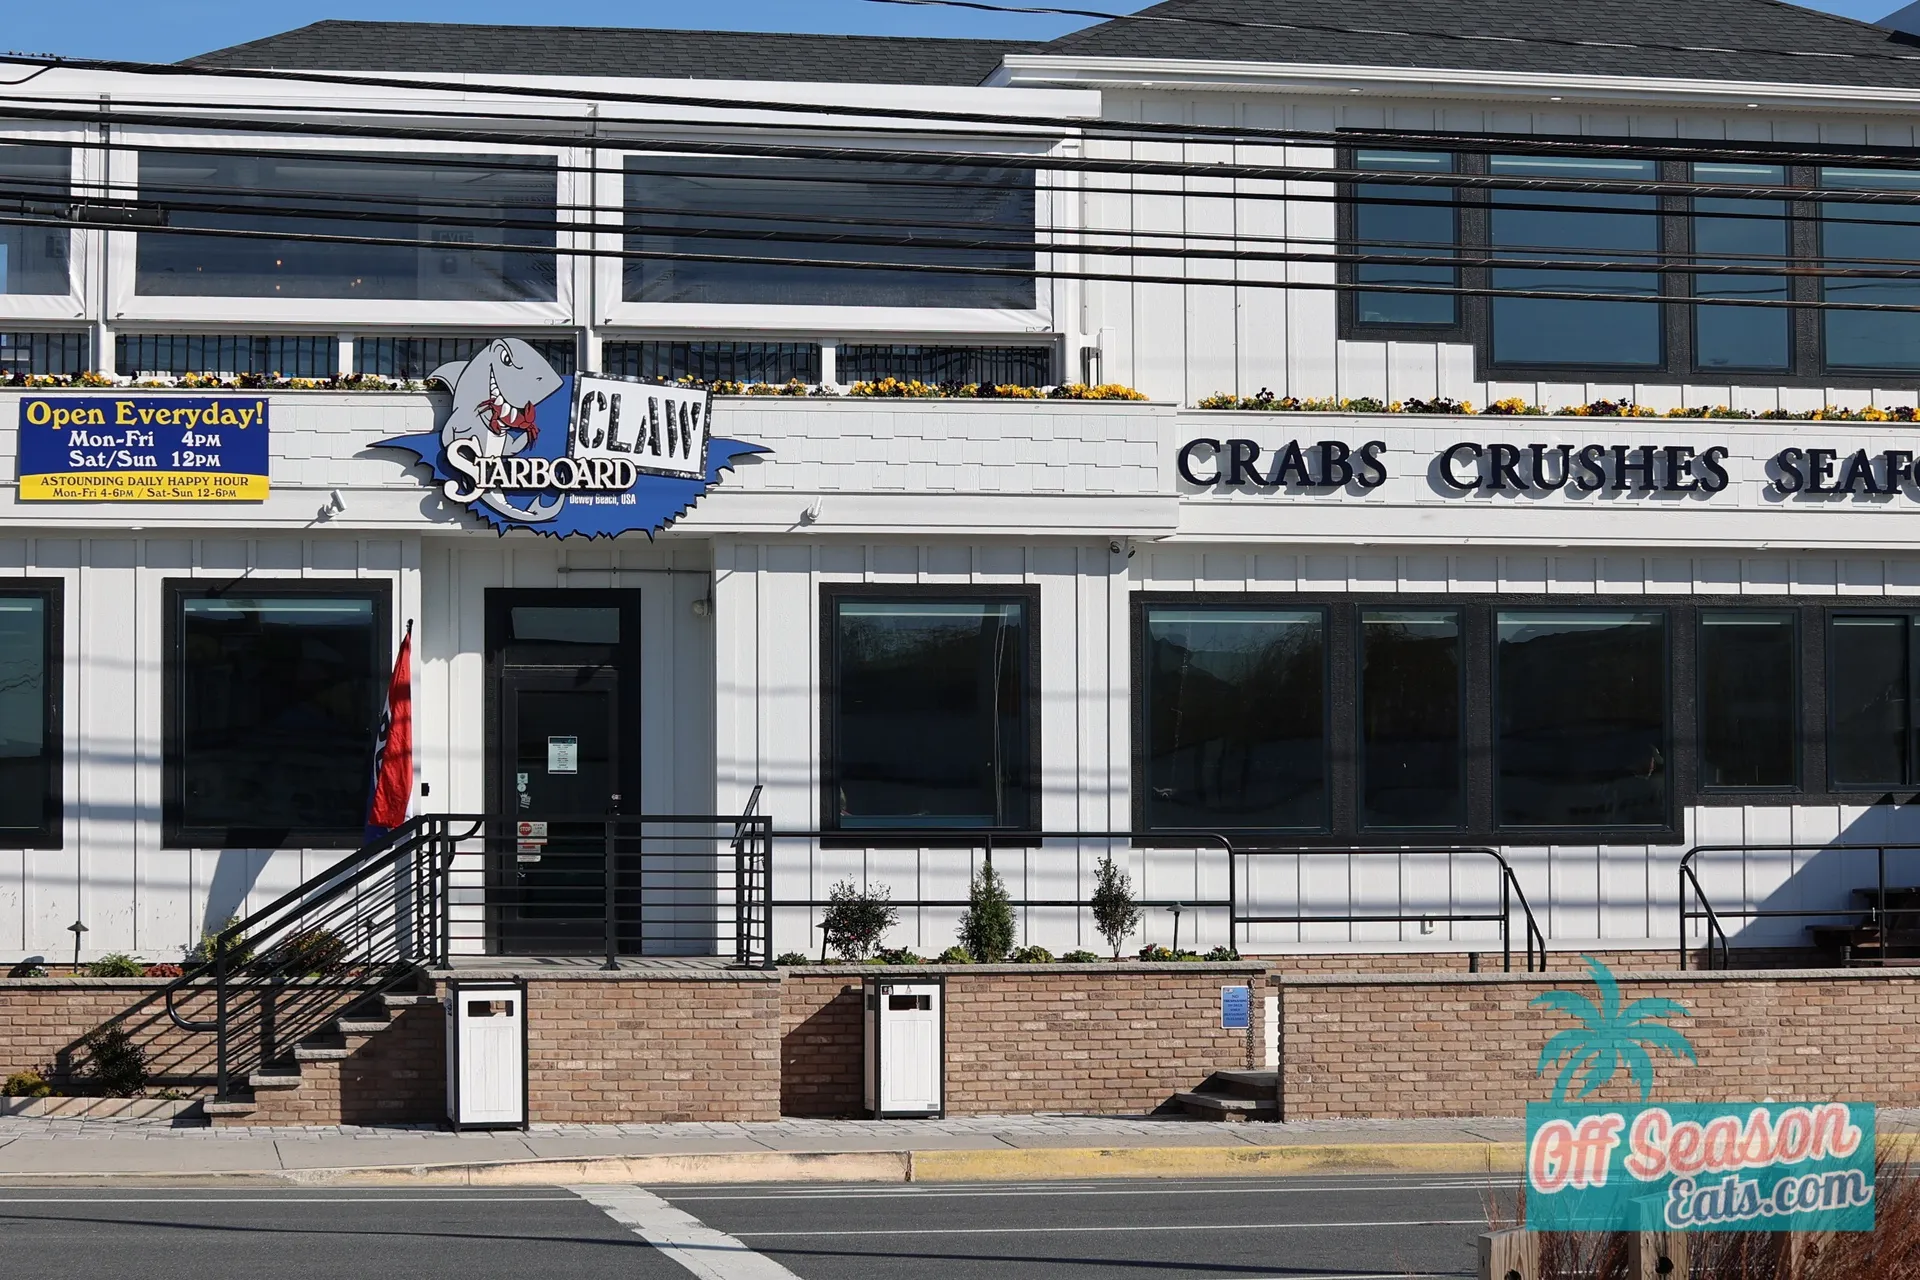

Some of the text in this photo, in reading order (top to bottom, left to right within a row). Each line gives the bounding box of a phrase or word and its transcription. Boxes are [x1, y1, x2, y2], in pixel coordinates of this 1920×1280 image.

[26, 401, 266, 429] Open Everyday!
[577, 390, 701, 461] CLAW
[68, 430, 222, 448] Mon-Fri 4PM
[69, 450, 221, 468] Sat/Sun 12PM
[443, 438, 637, 503] STARBOARD
[1178, 438, 1388, 488] CRABS
[1439, 442, 1729, 492] CRUSHES
[1774, 447, 1920, 495] SEAF
[41, 476, 249, 487] ASTOUNDING DAILY HAPPY HOUR
[53, 488, 97, 498] Mon-Fri
[101, 488, 134, 498] 4-6PM
[147, 488, 193, 498] Sat-Sun
[197, 488, 237, 498] 12-6PM
[569, 493, 637, 506] Dewey Beach, USA
